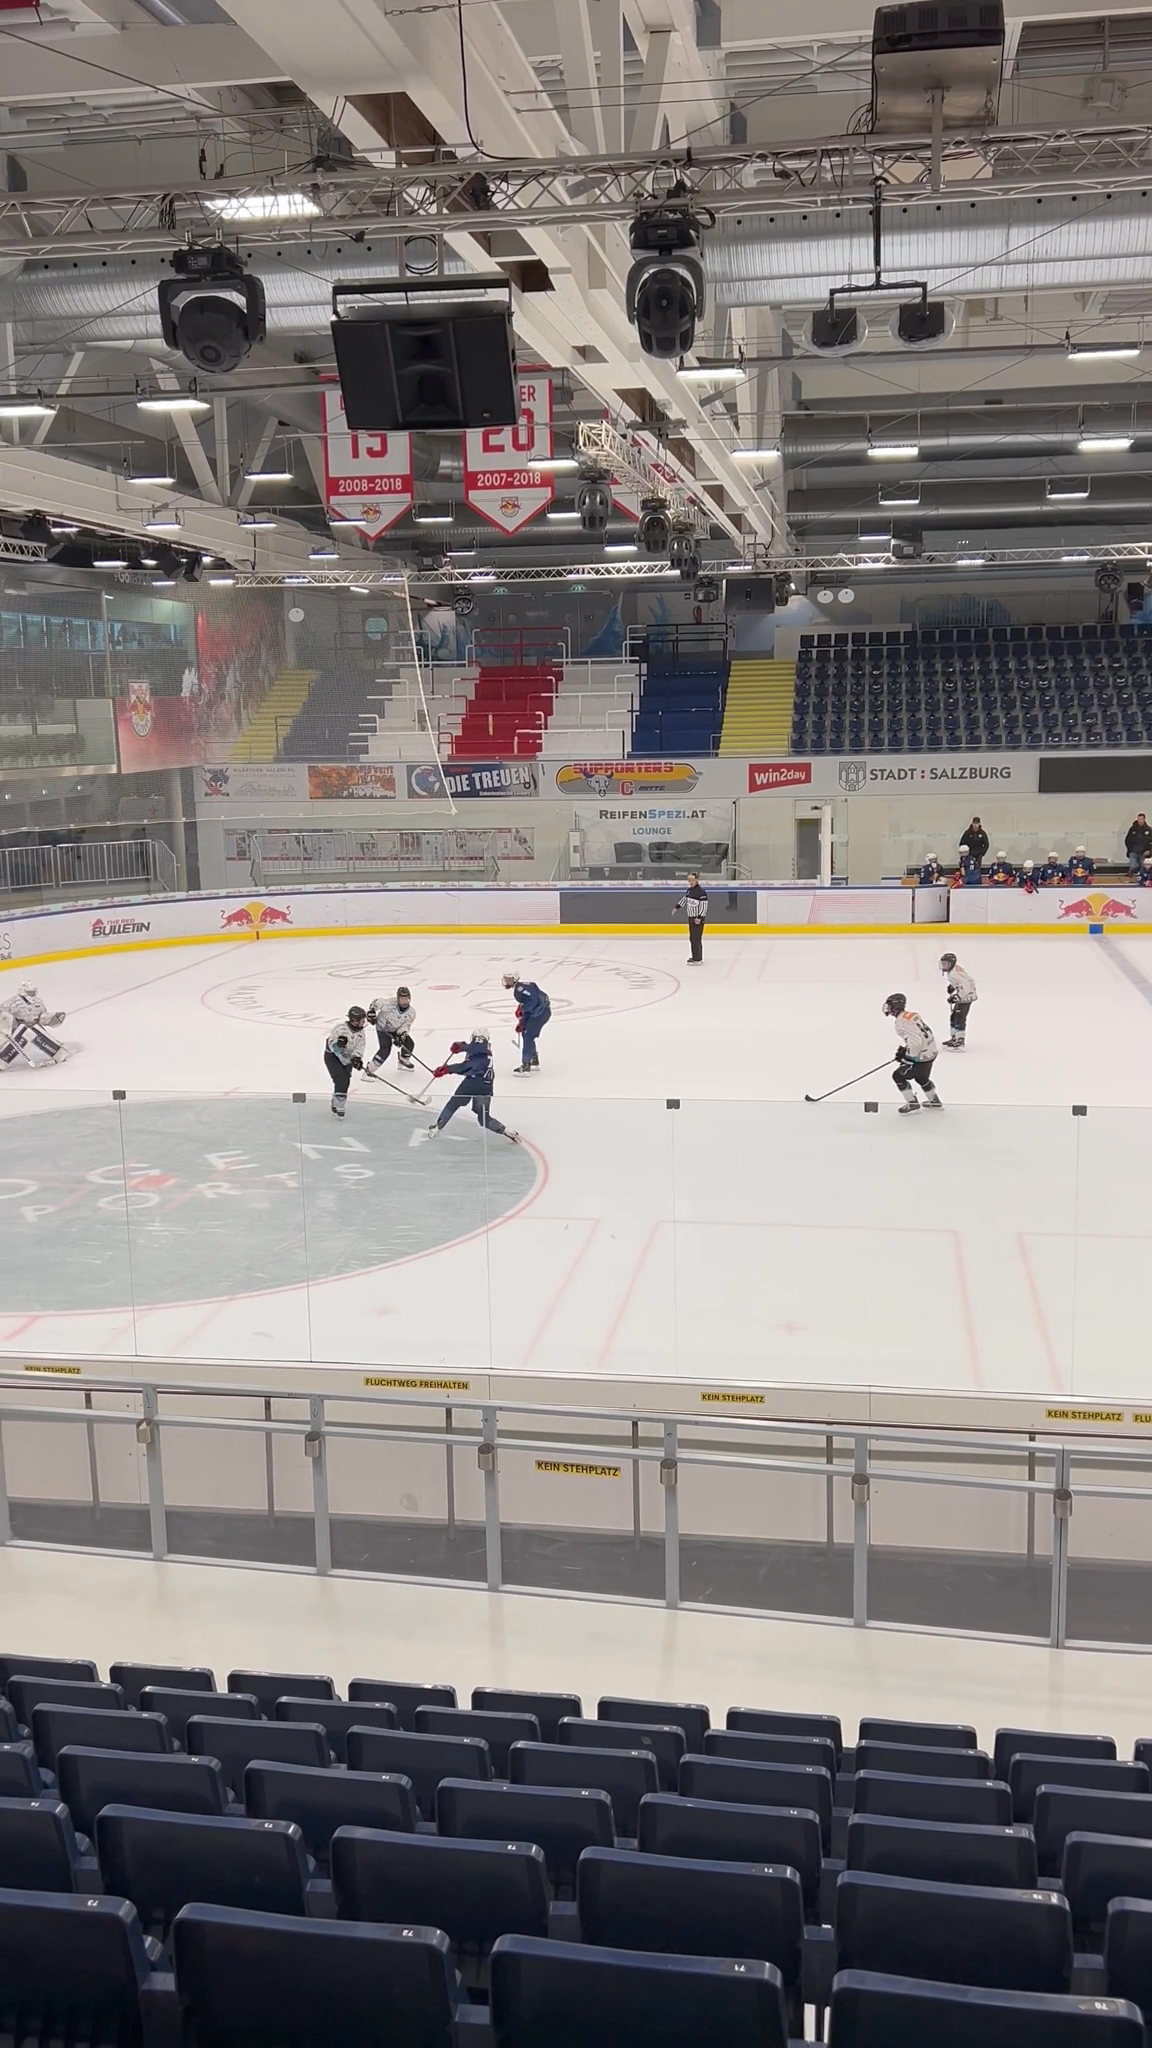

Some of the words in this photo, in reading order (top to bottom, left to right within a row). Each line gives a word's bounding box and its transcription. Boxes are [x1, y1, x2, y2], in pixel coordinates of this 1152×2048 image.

[338, 477, 402, 493] 2008-2018
[477, 471, 541, 487] 2007-2018
[573, 762, 674, 774] SUPPORTERS
[869, 768, 918, 781] STADT
[929, 766, 1012, 780] SALZBURG
[445, 773, 471, 793] DIE
[472, 766, 531, 790] TREUEN
[754, 768, 806, 786] win2day
[632, 827, 673, 836] LOUNGE
[365, 1378, 418, 1388] FLUCHTWEG
[419, 1380, 468, 1390] FREIHALTEN
[702, 1393, 720, 1401] KEIN
[722, 1394, 764, 1403] STEHPLATZ
[1047, 1409, 1069, 1418] KEIN
[1071, 1411, 1122, 1421] STEHPLATZ
[537, 1461, 561, 1472] KEIN
[563, 1463, 620, 1477] STEHPLATZ
